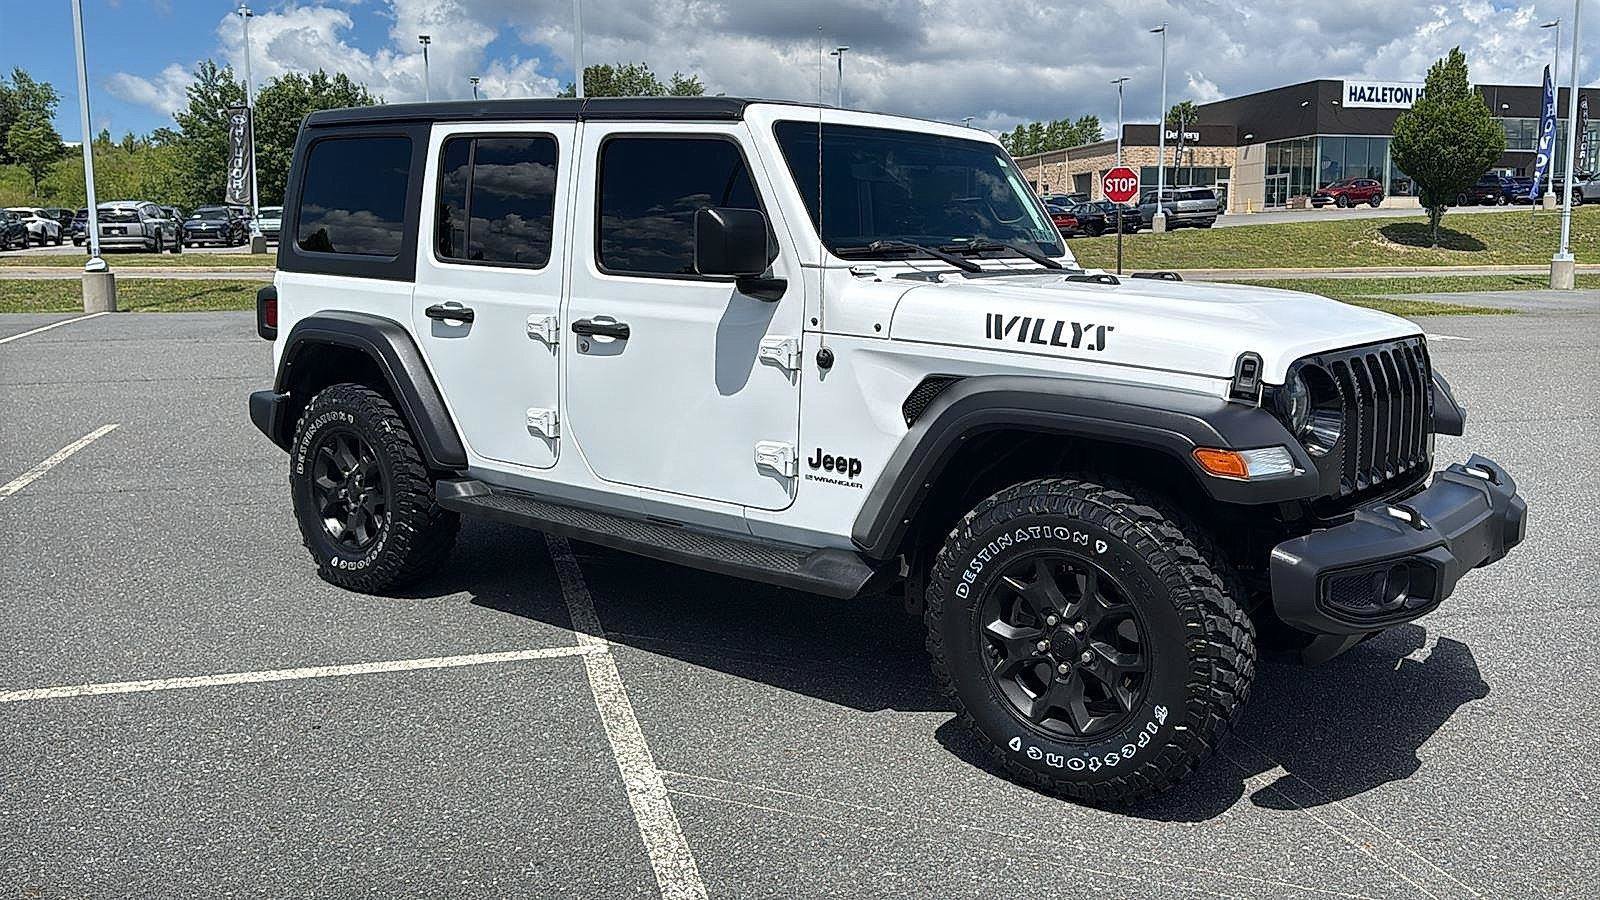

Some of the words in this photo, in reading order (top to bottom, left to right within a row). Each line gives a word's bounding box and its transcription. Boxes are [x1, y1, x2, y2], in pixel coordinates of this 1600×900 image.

[1347, 86, 1413, 103] HAZLETON
[1165, 130, 1200, 142] Delvery
[232, 126, 244, 200] HYUNDAI
[1105, 177, 1137, 193] STOP
[985, 313, 1115, 351] WILLYS
[807, 447, 862, 479] Jeep
[813, 475, 863, 489] WRANGLER
[955, 526, 1089, 599] DESTINATION
[1026, 705, 1168, 773] Firestone
